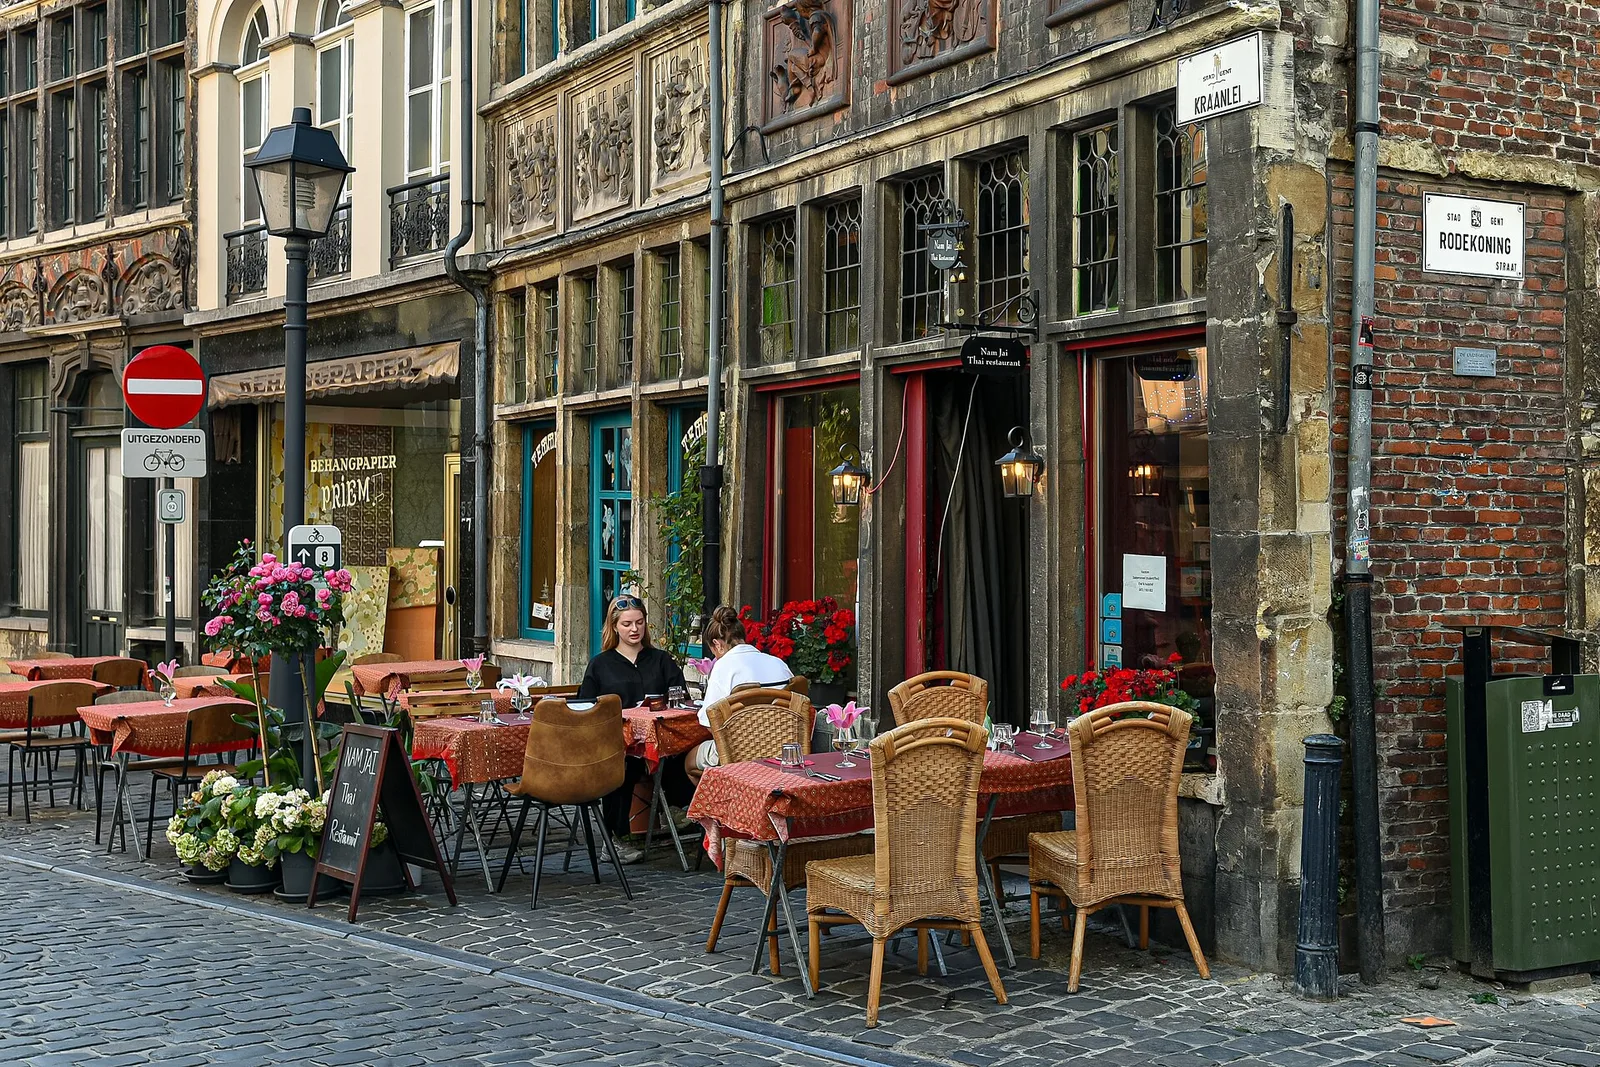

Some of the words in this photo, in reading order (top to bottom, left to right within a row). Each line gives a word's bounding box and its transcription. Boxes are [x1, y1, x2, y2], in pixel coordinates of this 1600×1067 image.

[1202, 73, 1216, 82] STAD
[1219, 67, 1232, 77] GENT
[1194, 84, 1241, 115] KRAANLEI
[1446, 212, 1461, 222] STAD
[1490, 217, 1504, 226] GENT
[934, 239, 945, 250] Nam
[945, 239, 953, 252] Jai
[1439, 231, 1512, 255] RODEKONING
[1495, 261, 1517, 272] STRAAT
[980, 347, 998, 357] Nam
[998, 347, 1009, 358] Jai
[967, 355, 985, 366] Thai
[985, 357, 1021, 367] restaurant
[127, 434, 201, 444] UITGEZONDERD
[310, 454, 397, 473] BEHANGPAPIER
[321, 551, 329, 563] 8
[343, 746, 363, 768] NAM
[359, 749, 380, 776] JAI
[342, 782, 357, 806] Thai
